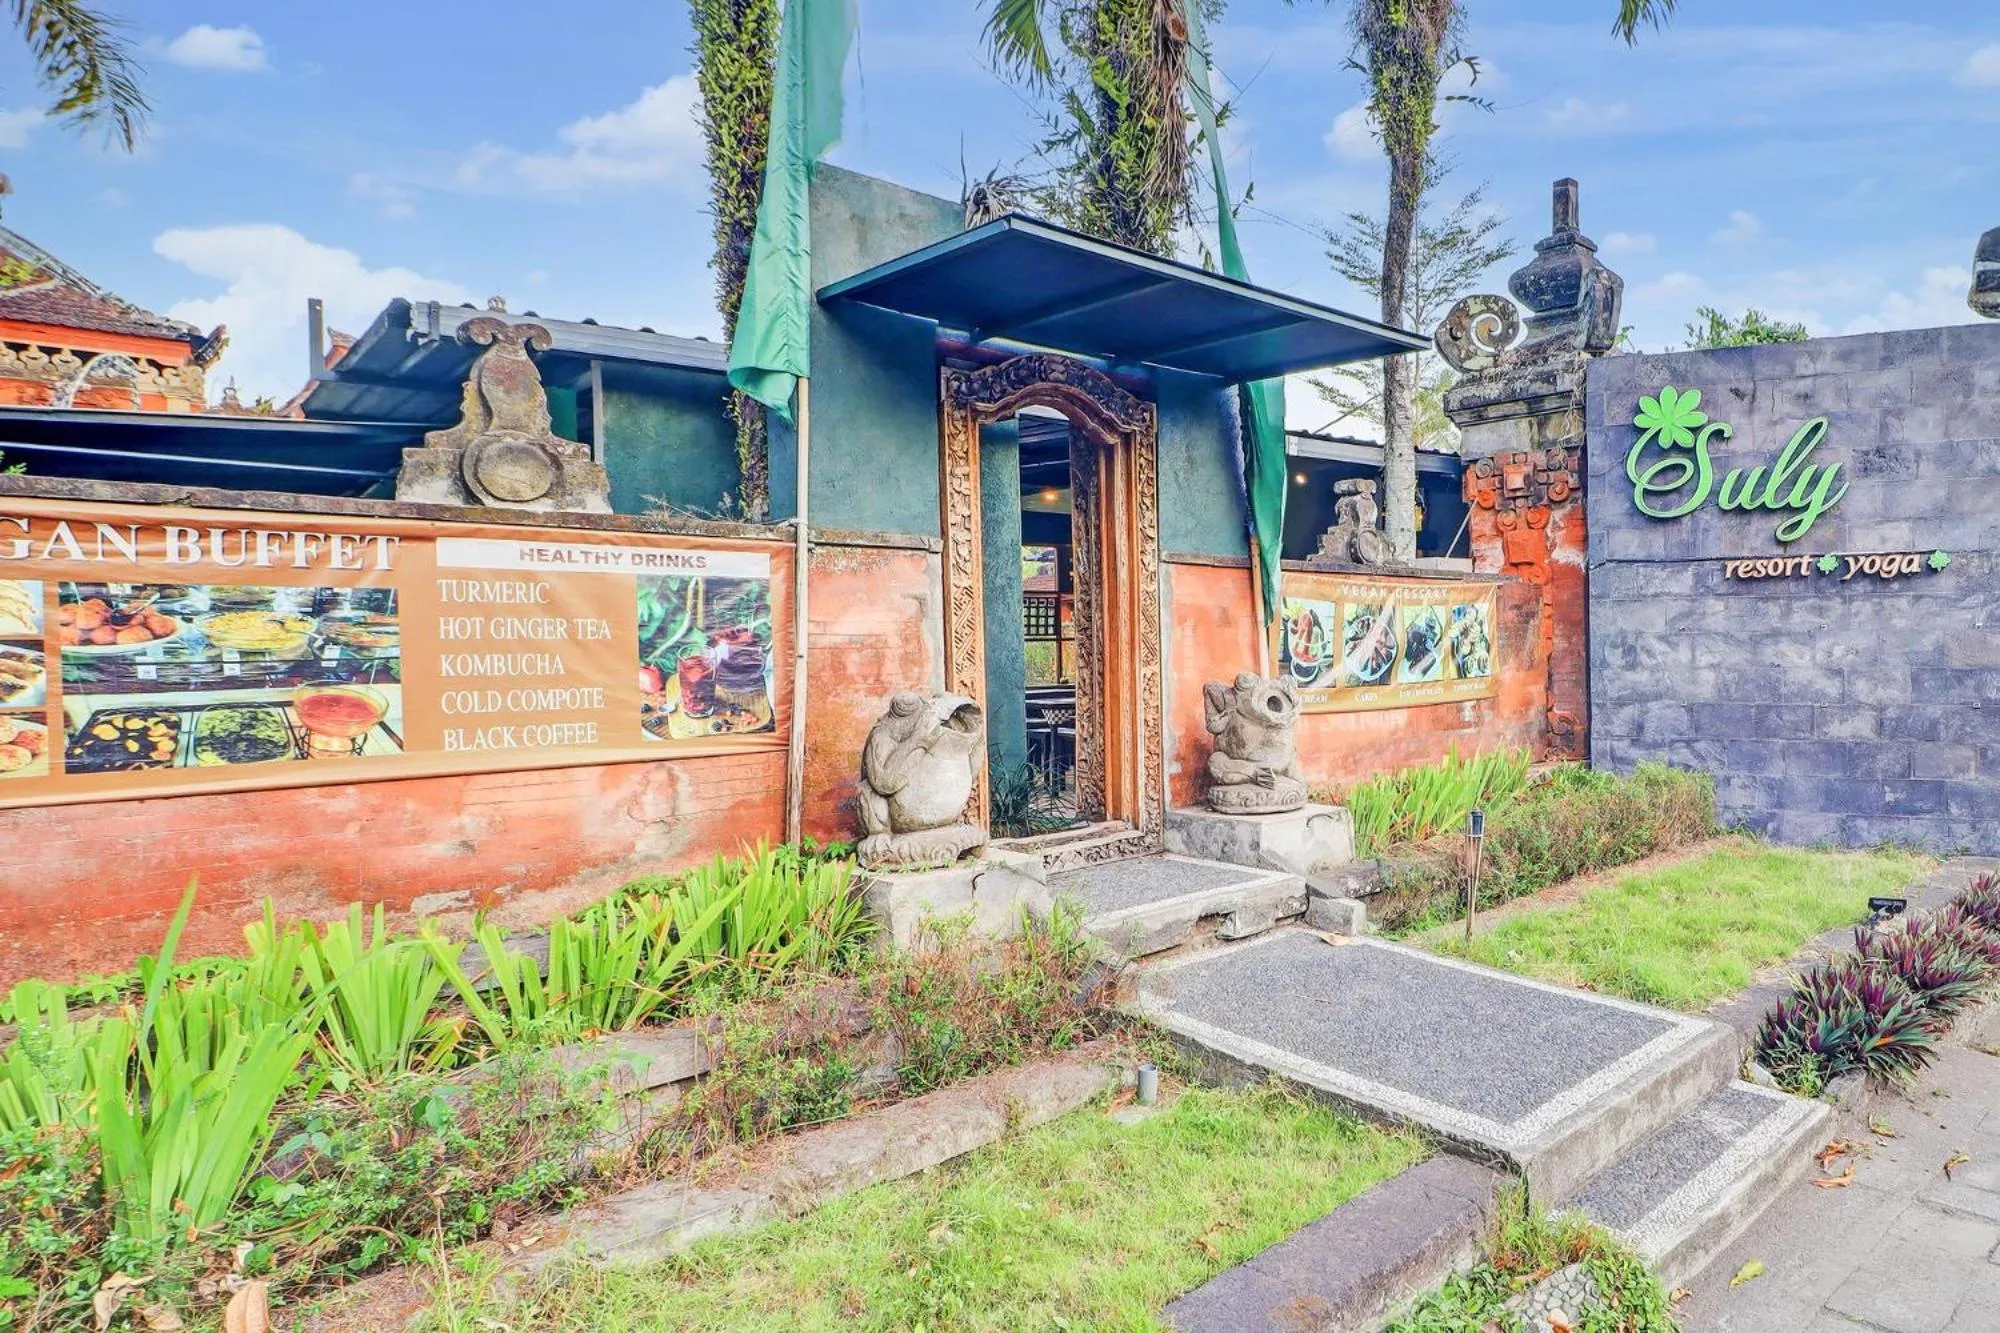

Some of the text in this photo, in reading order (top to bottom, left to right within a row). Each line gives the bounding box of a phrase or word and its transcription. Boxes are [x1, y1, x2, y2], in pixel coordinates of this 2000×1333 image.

[1625, 415, 1850, 543] Suly
[0, 515, 401, 571] GAN BUFFET
[519, 547, 708, 569] HEALTHY DRINKS
[1724, 551, 1922, 581] resort yoga
[436, 578, 551, 605] TURMERIC
[438, 616, 612, 641] HOT GINGER TEA
[439, 652, 566, 678] KOMBUCHA
[440, 686, 605, 715] COLD COMPOTE
[443, 721, 600, 753] BLACK COFFEE
